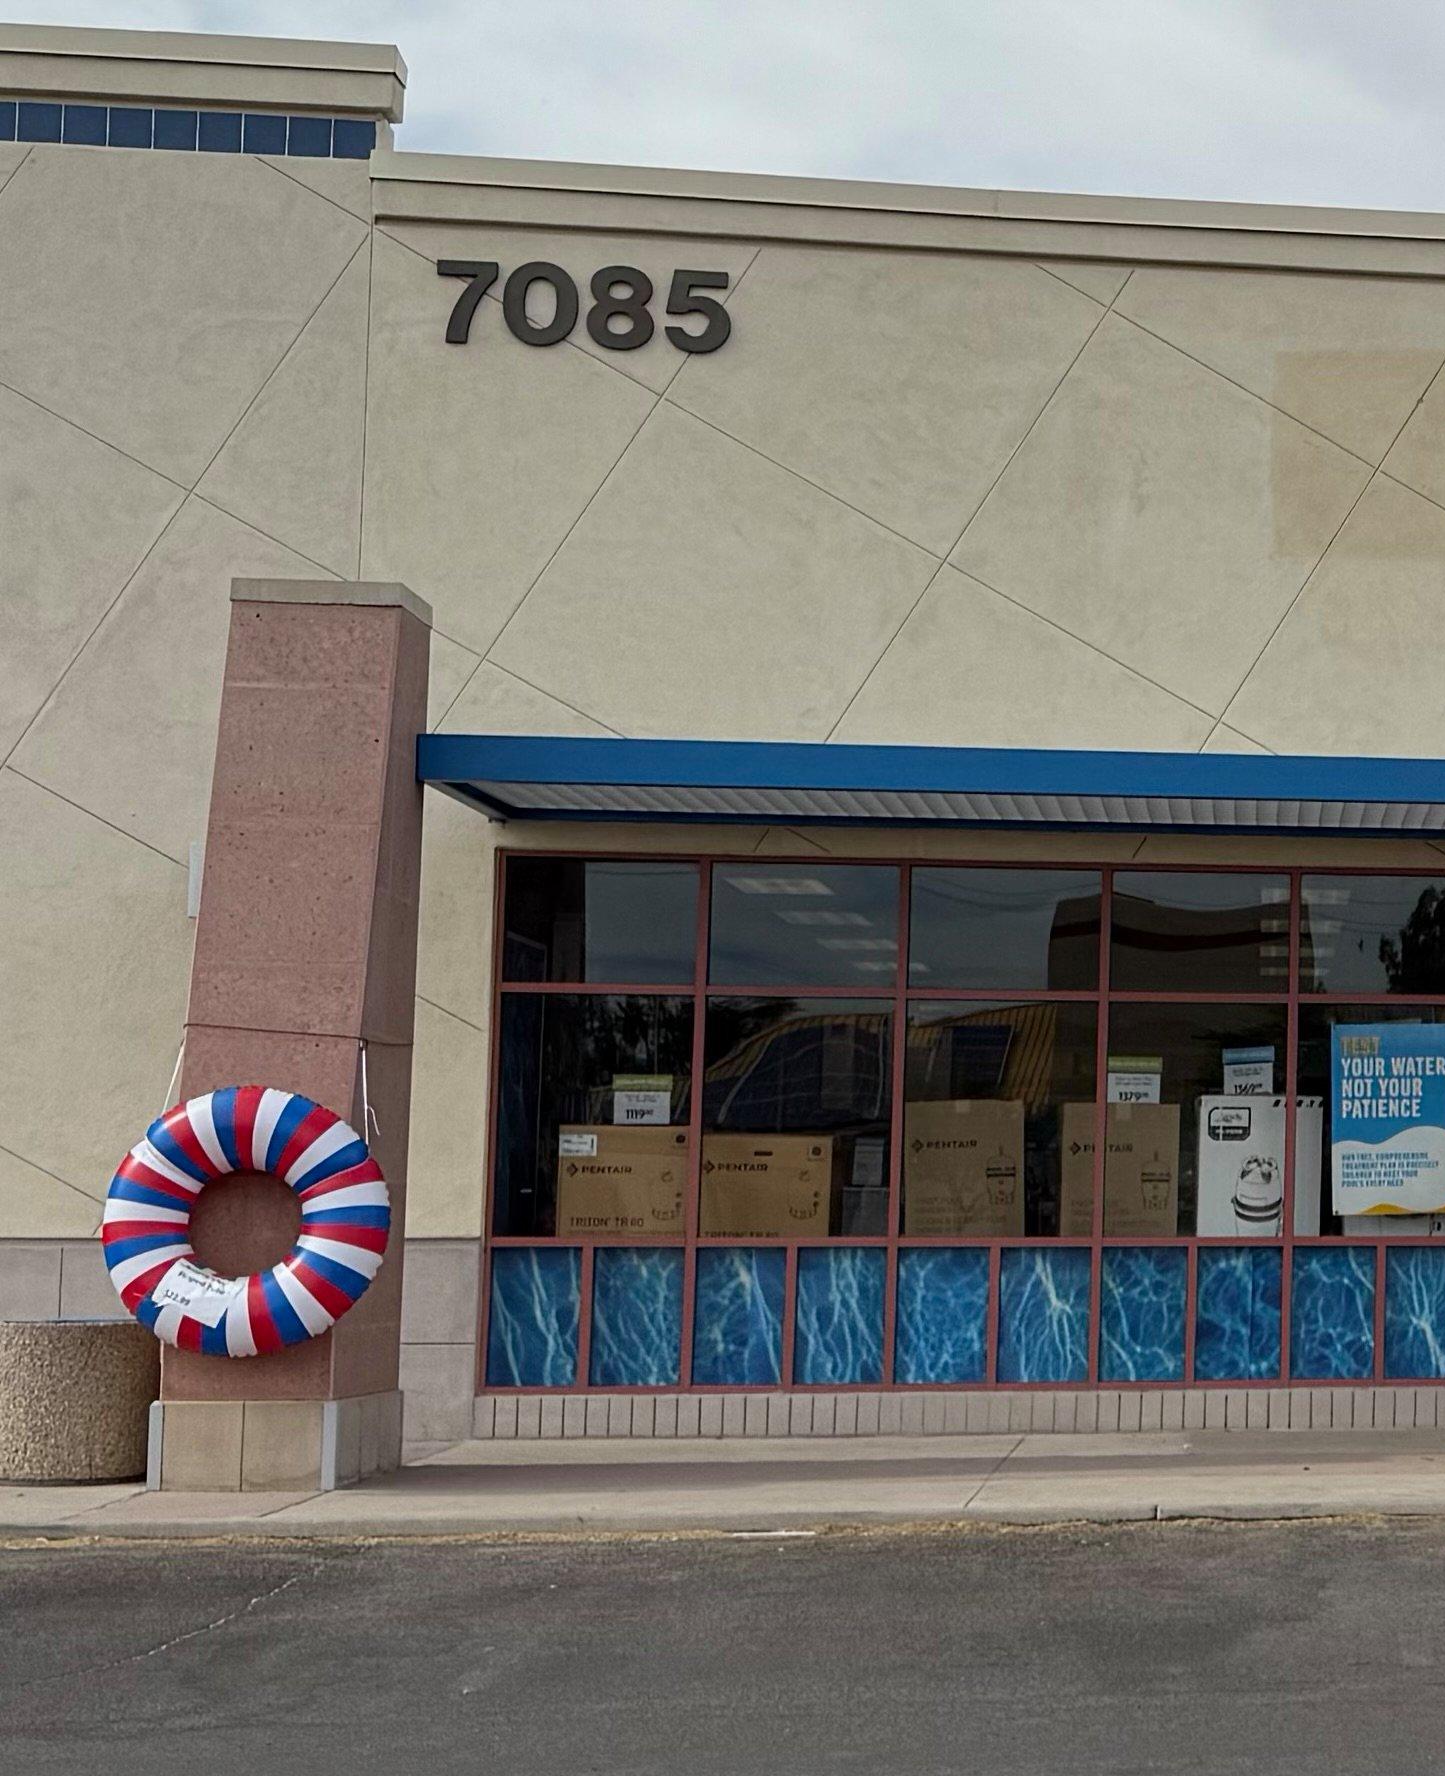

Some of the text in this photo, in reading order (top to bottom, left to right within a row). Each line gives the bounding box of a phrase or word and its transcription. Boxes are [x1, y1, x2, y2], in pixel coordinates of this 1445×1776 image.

[437, 259, 731, 354] 7085
[1341, 1057, 1385, 1076] YOUR
[1342, 1078, 1423, 1098] NOT YOUR
[1342, 1099, 1421, 1118] PATIENCE
[581, 1165, 632, 1175] PENTAIR
[717, 1161, 768, 1172] PENTAIR
